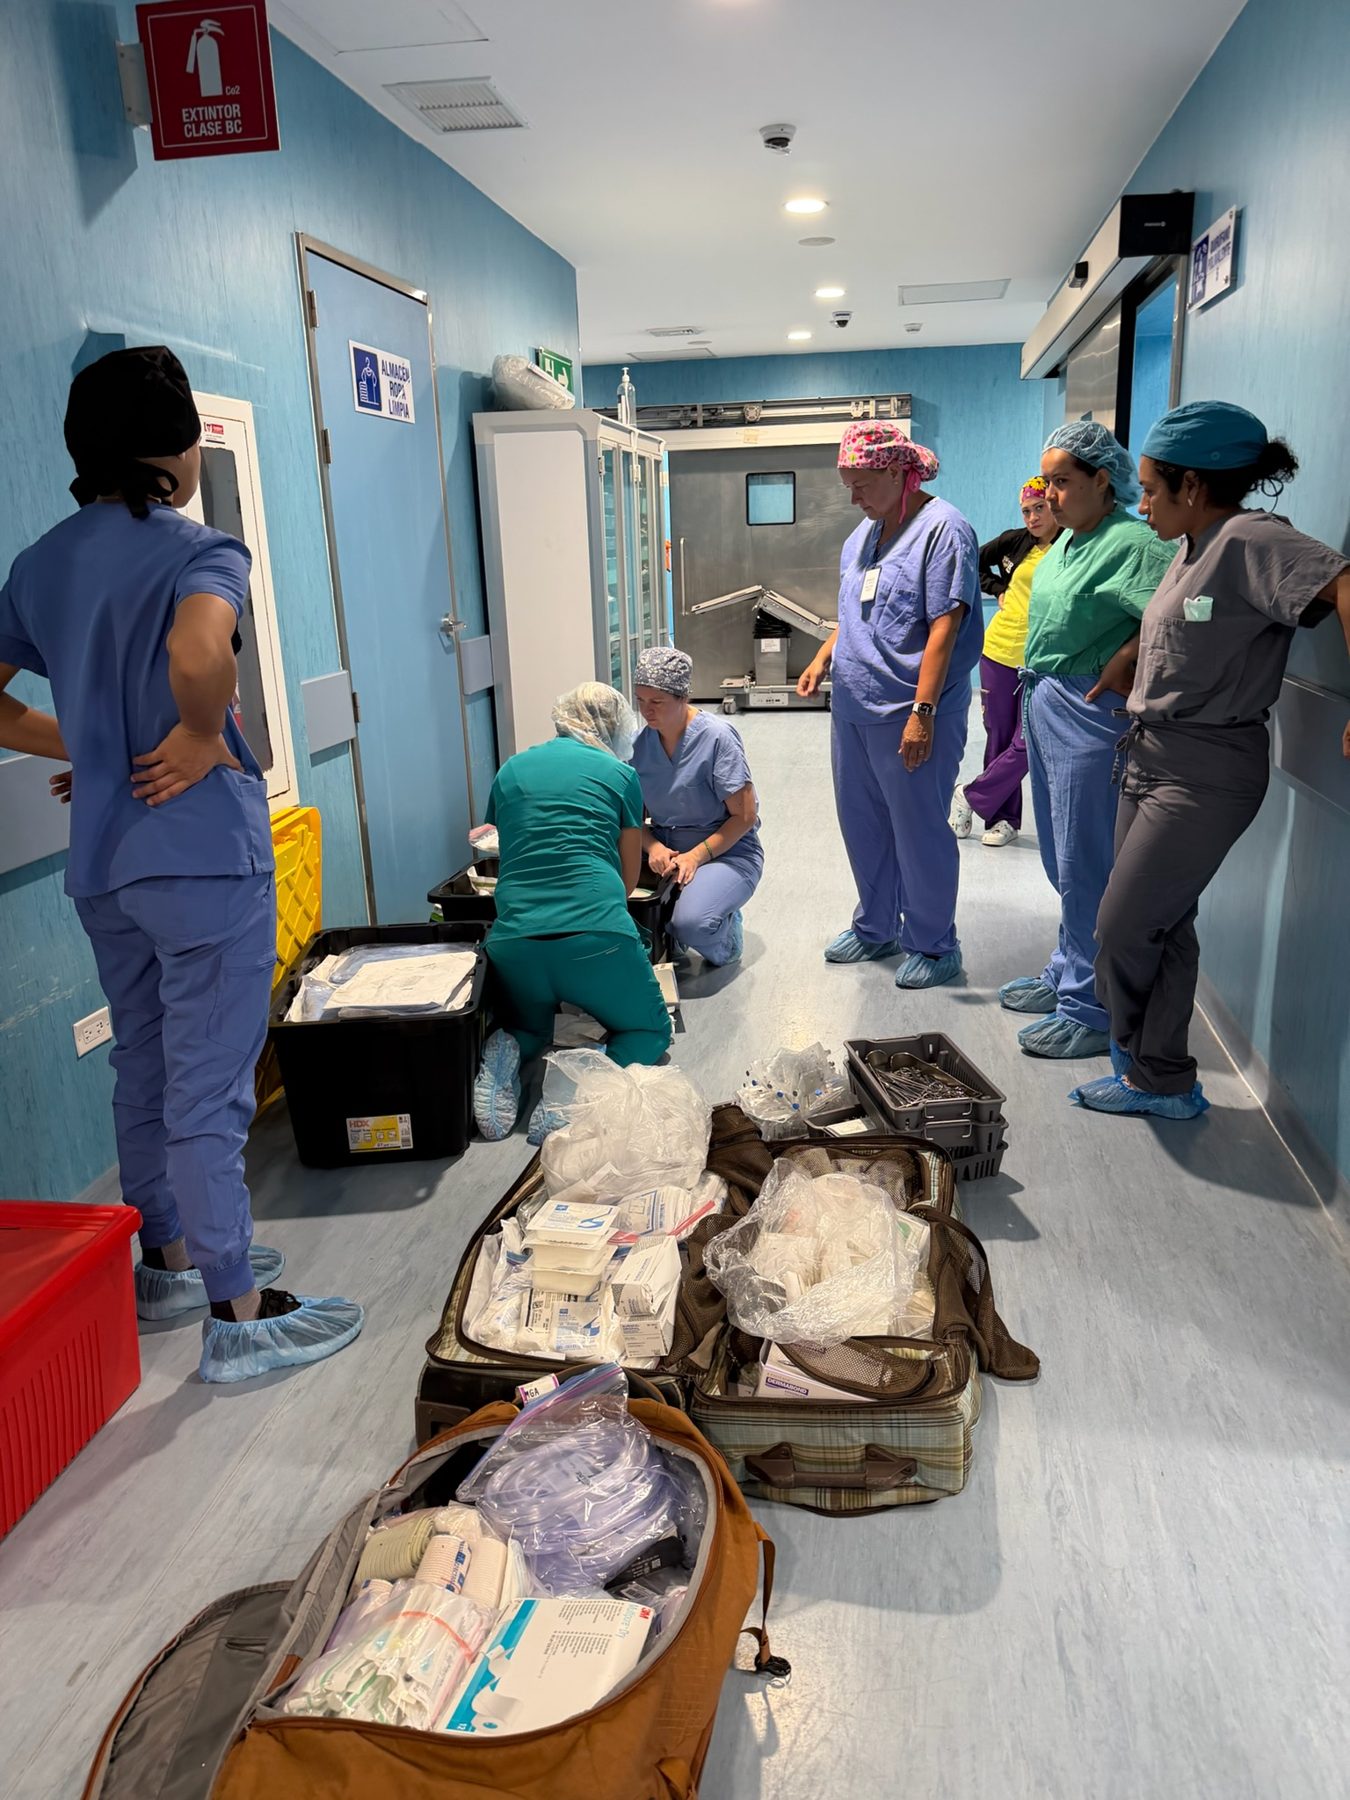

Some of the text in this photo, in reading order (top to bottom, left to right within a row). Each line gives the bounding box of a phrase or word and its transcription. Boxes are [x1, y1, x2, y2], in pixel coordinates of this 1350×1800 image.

[181, 103, 241, 123] EXTINTOR
[183, 119, 243, 138] CLASE BC
[389, 380, 407, 400] ROPA
[388, 399, 410, 419] LIMPIA
[349, 1119, 370, 1128] HDX
[767, 1377, 809, 1395] DERMABOND
[639, 1606, 651, 1620] 3M
